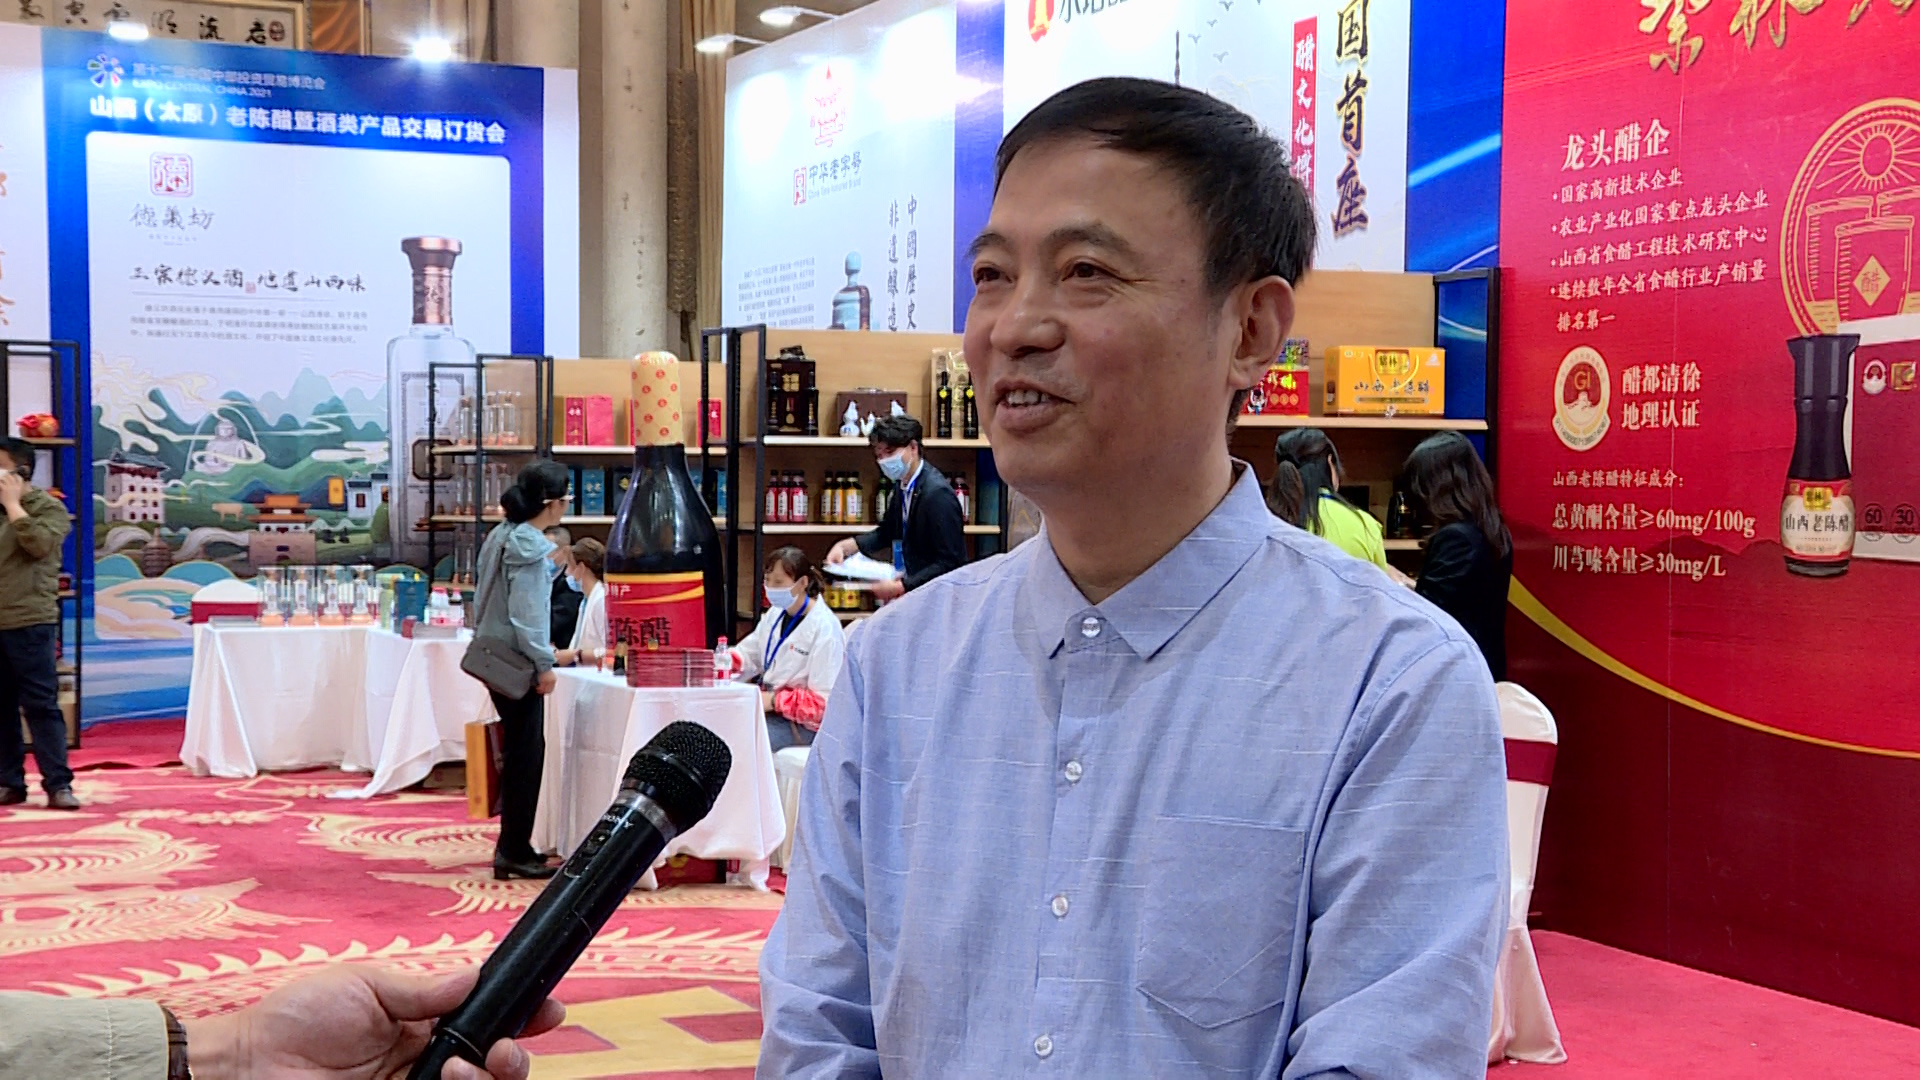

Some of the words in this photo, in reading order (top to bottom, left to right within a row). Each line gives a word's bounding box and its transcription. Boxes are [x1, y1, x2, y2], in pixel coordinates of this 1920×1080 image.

[1561, 118, 1671, 172] 龙头醋企
[808, 151, 862, 186] 中华老字号
[1561, 167, 1684, 204] 国家高新技术企业
[1559, 189, 1770, 239] 农业产业化国家重点龙头企业
[1559, 225, 1768, 268] 山西省食醋工程技术研究中心
[1557, 258, 1767, 300] 连续数年全省食醋行业产销量
[1557, 308, 1616, 332] 排名第一
[1574, 371, 1591, 391] GI
[1621, 361, 1702, 395] 醋都清徐
[1621, 398, 1701, 430] 地理认证
[1865, 508, 1883, 524] 60
[1896, 508, 1914, 525] 30
